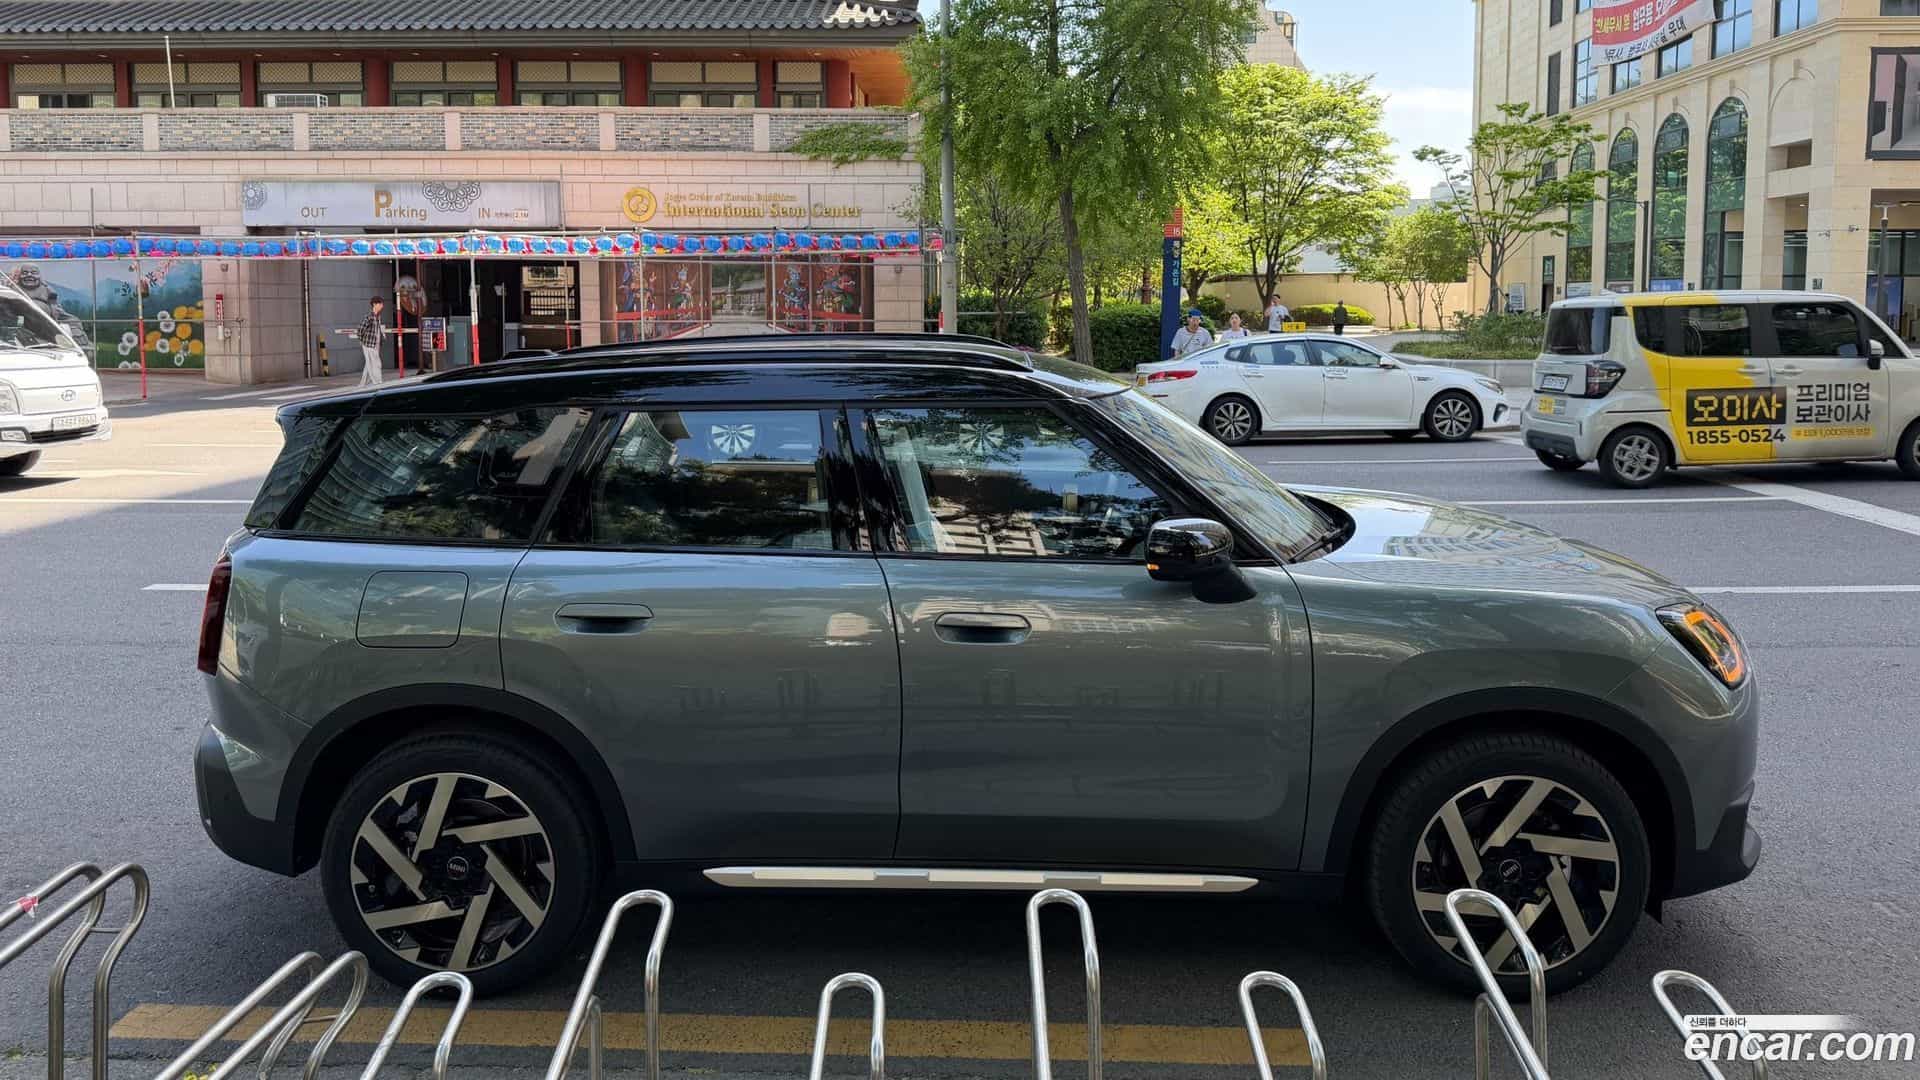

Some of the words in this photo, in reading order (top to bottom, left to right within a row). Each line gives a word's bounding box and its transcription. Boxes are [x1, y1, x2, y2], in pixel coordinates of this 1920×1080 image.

[1668, 15, 1688, 37] 우대
[300, 206, 327, 218] OUT
[374, 190, 428, 221] Parking
[478, 207, 491, 219] IN
[664, 202, 764, 217] International
[769, 202, 806, 217] Seon
[811, 202, 862, 218] Center
[1796, 382, 1870, 403] 프리미엄
[1795, 403, 1871, 424] 보관이사
[1687, 428, 1786, 444] 1855-0524
